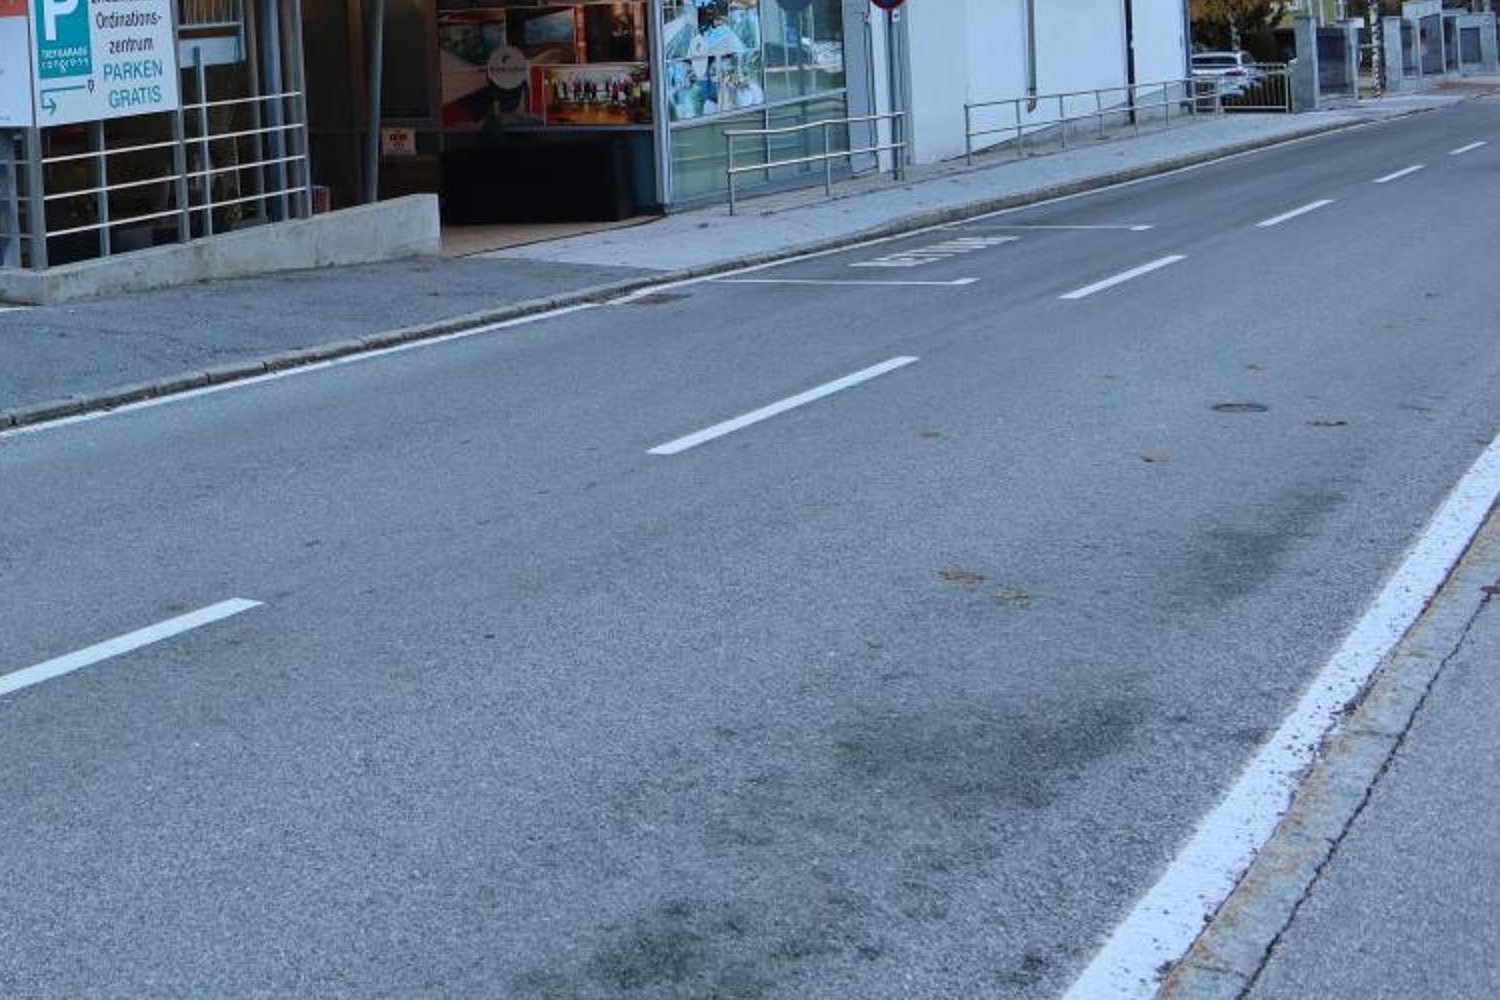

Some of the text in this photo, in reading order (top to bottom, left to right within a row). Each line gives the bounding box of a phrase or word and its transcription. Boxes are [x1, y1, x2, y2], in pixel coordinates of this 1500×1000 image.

[109, 36, 155, 55] zentrum
[103, 59, 163, 81] PARKEN
[108, 85, 162, 109] GRATIS
